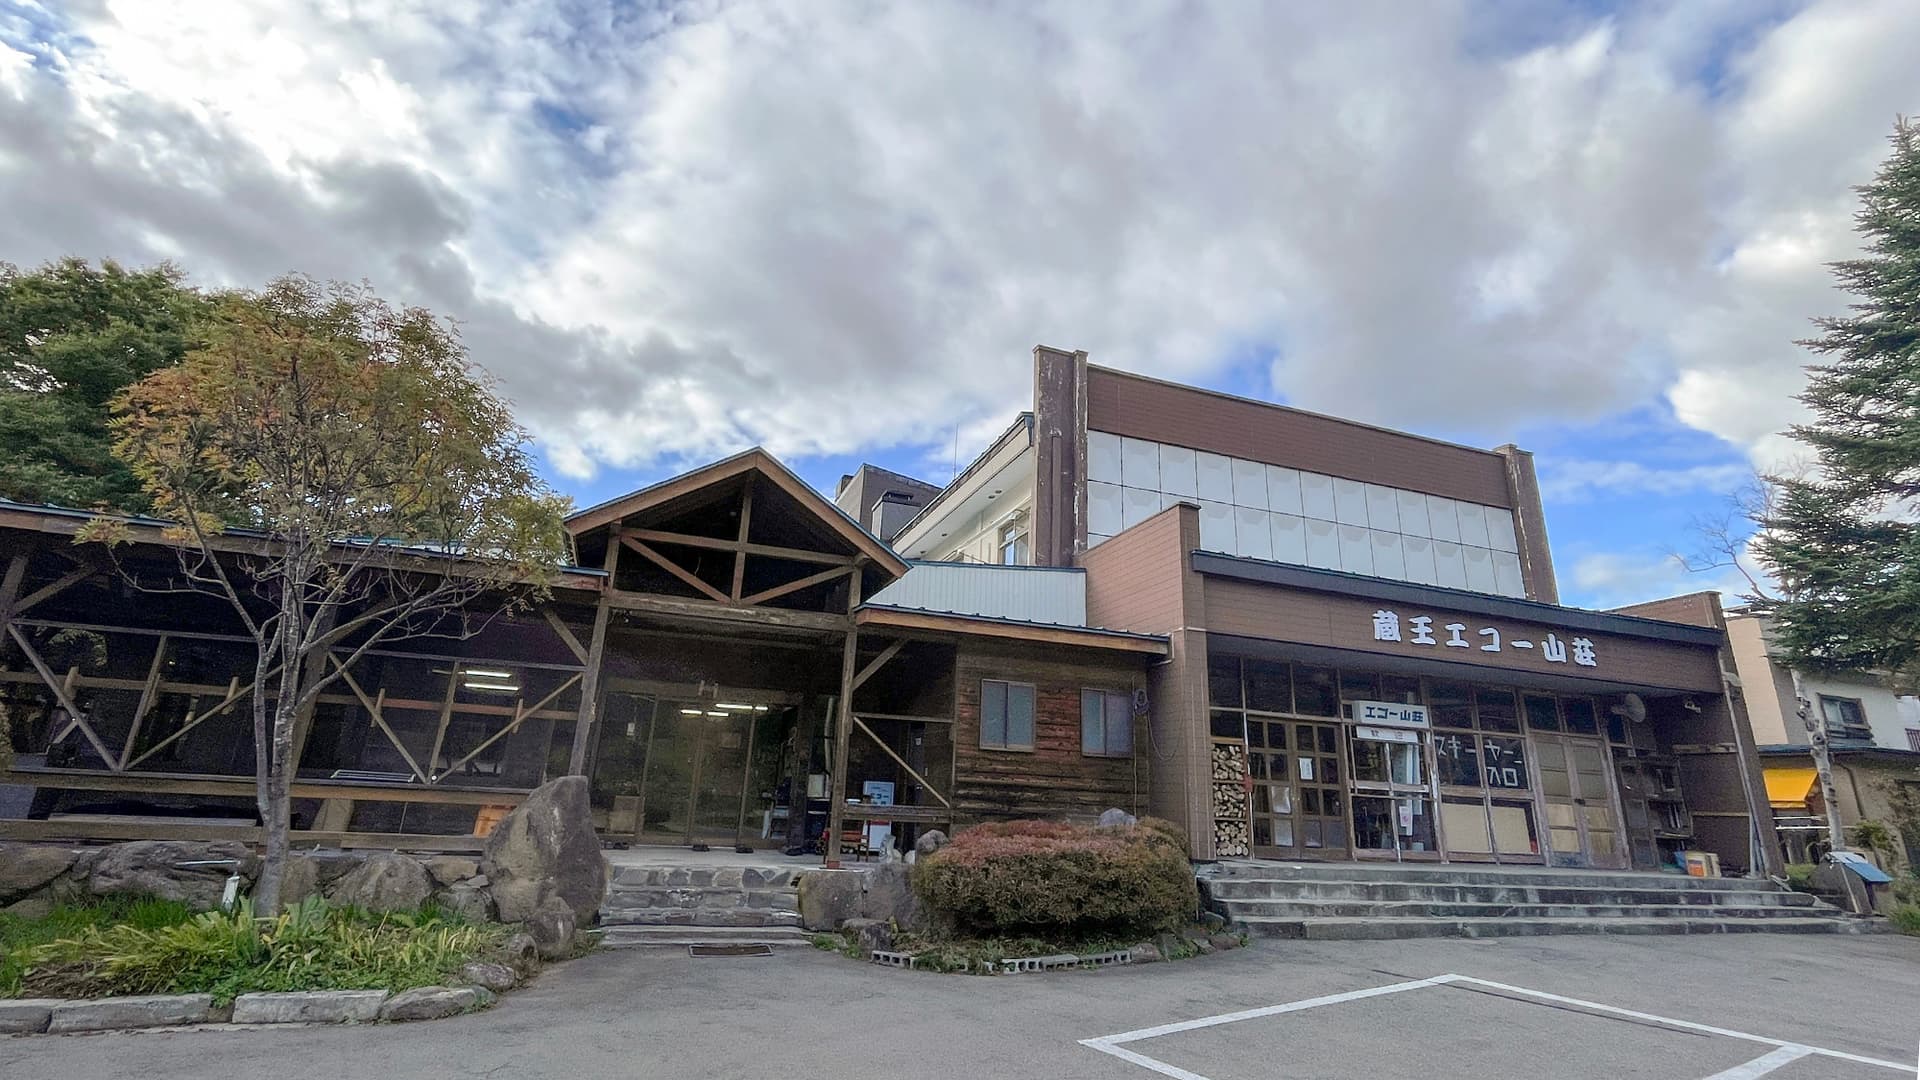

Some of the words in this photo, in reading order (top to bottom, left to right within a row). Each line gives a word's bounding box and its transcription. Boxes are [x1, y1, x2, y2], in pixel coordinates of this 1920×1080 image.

[1372, 609, 1597, 667] 蔵王エコー山荘
[1365, 706, 1423, 722] エコー山荘
[1434, 735, 1514, 761] スキーヤー
[1487, 767, 1518, 787] 入口
